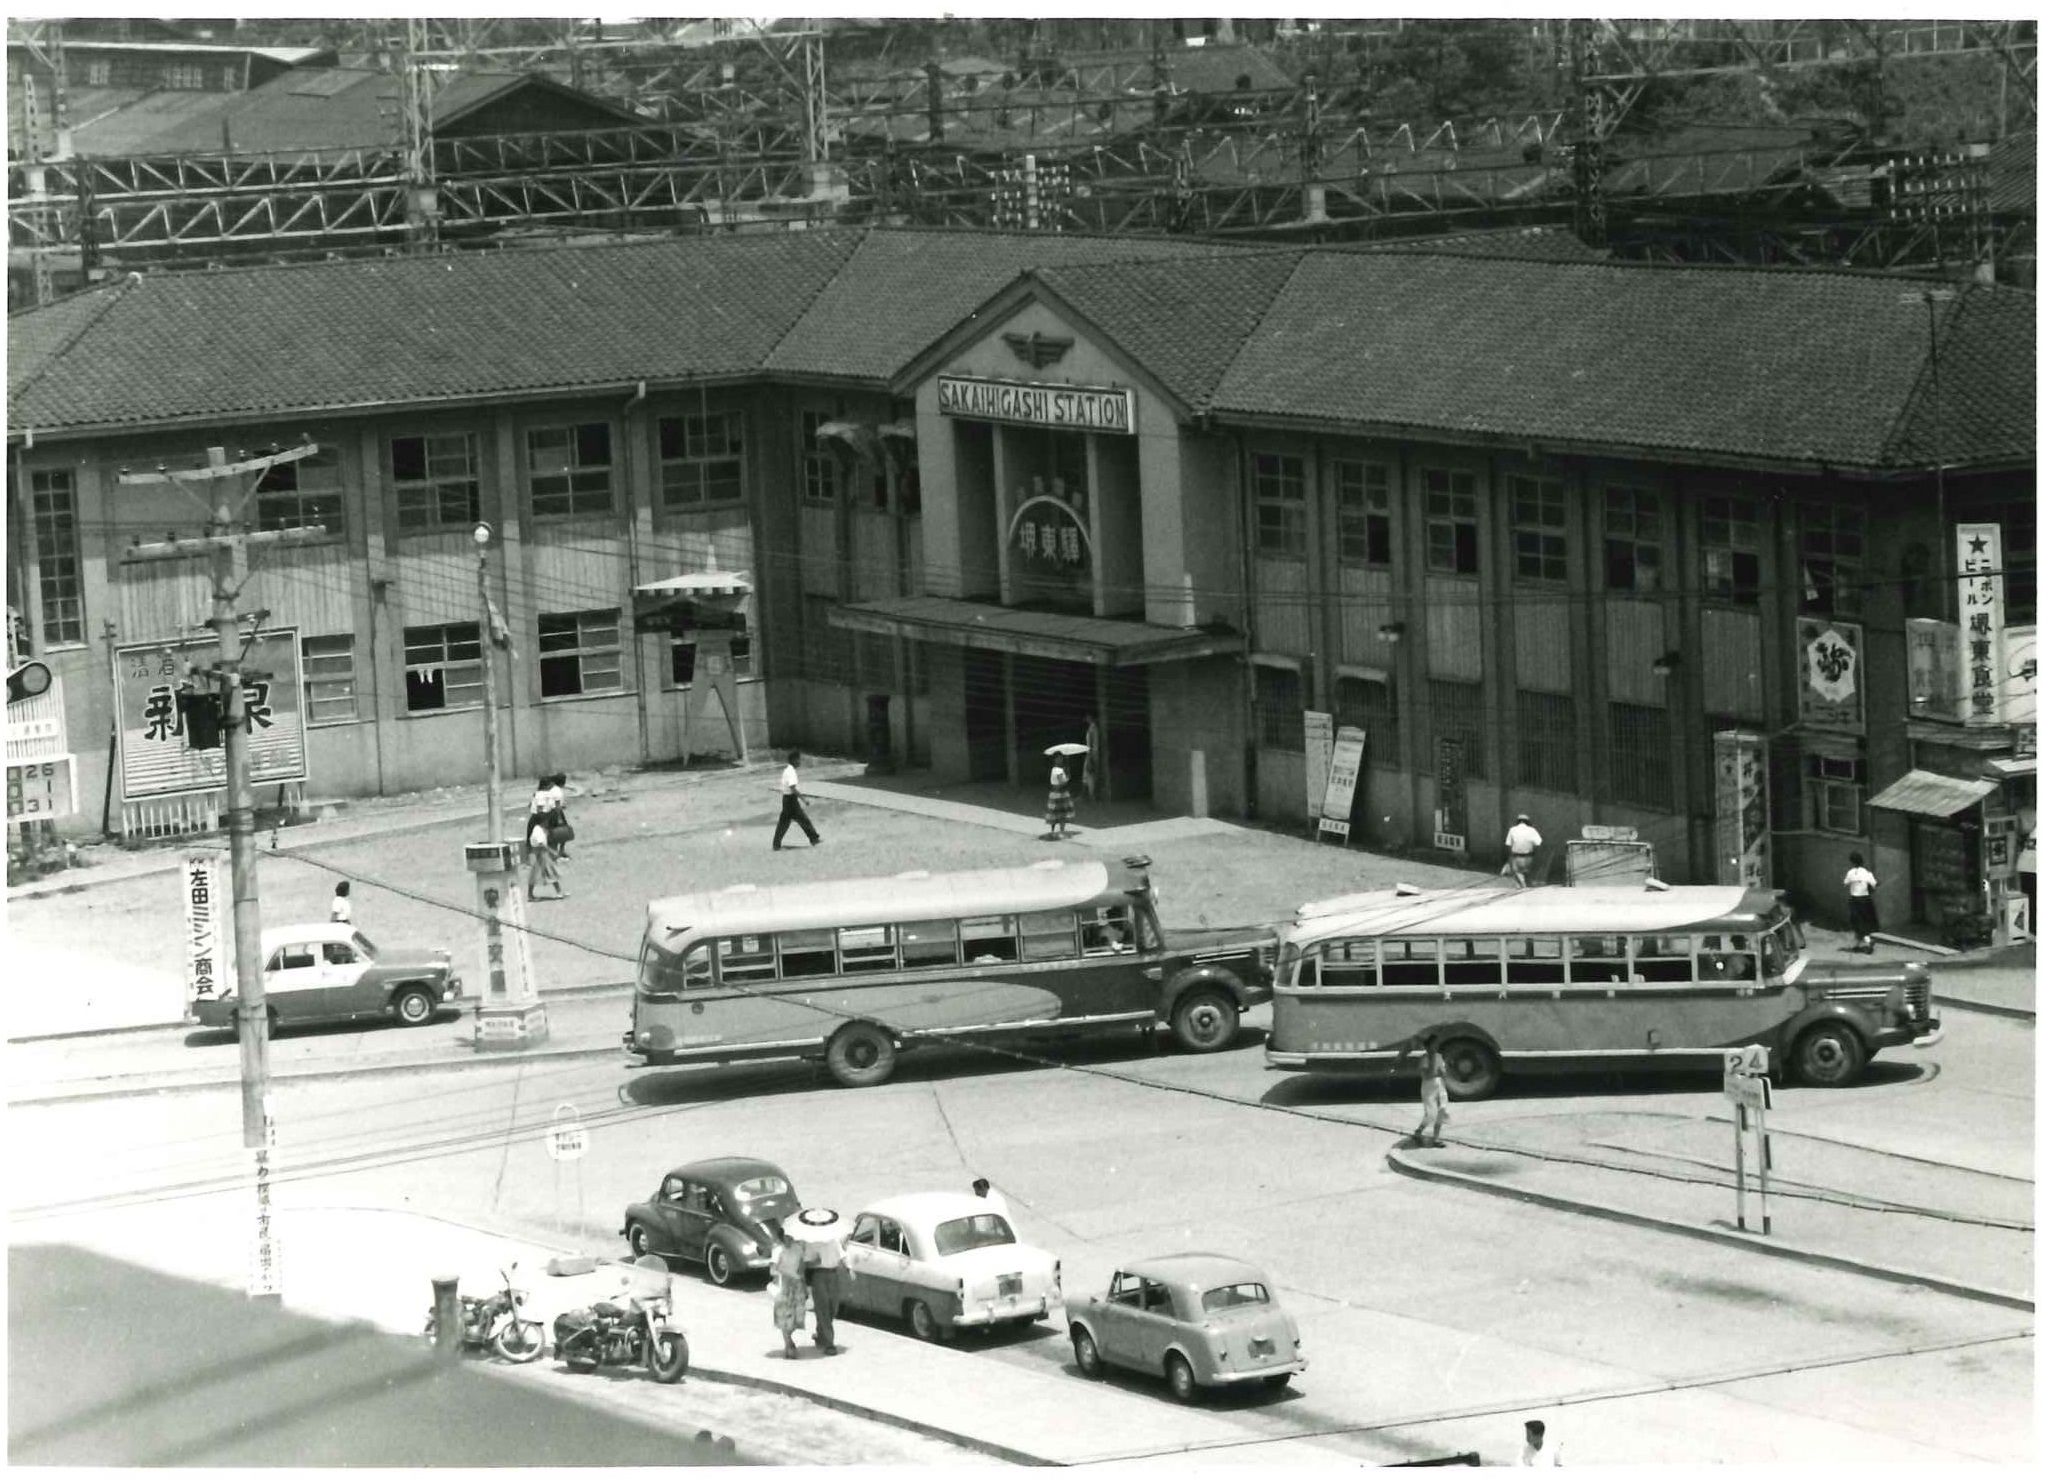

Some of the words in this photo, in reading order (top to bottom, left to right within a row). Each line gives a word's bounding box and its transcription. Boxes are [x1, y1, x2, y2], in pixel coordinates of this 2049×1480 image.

[941, 383, 1049, 420] SAKAIHIGASHI
[1054, 394, 1127, 425] STATION
[1965, 558, 1978, 605] ビール
[1969, 613, 1994, 715] 堺東食堂
[1729, 1051, 1764, 1075] 24
